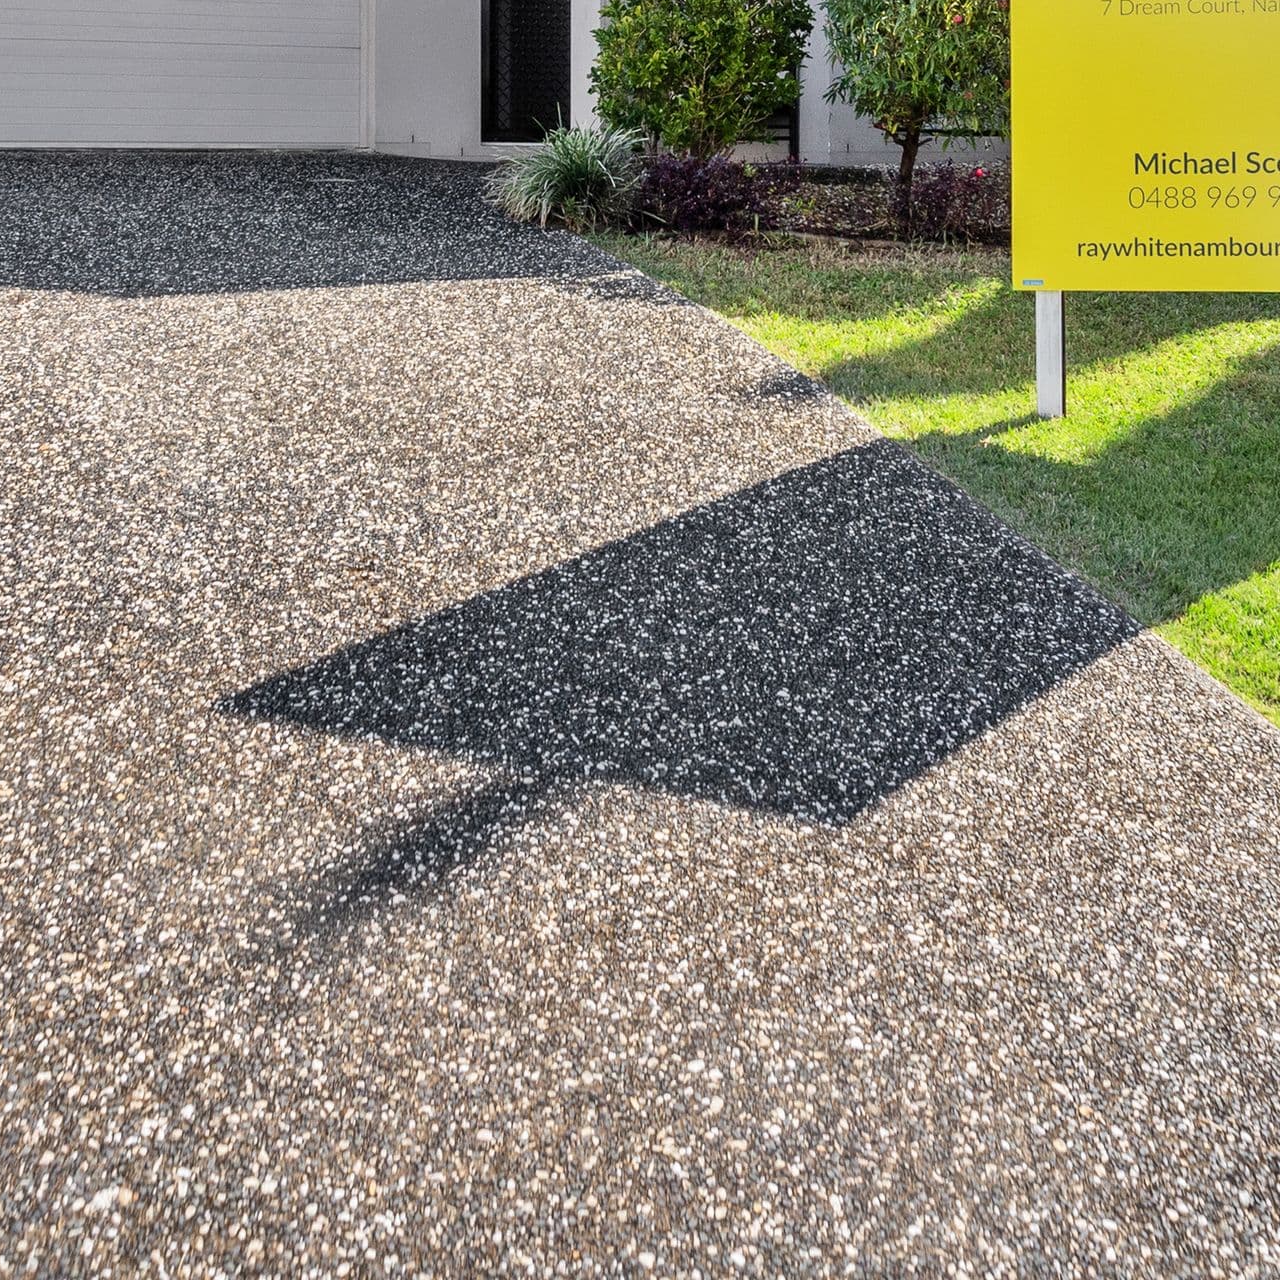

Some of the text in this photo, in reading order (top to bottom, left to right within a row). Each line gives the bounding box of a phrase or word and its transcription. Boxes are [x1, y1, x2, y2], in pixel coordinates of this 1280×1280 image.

[1101, 0, 1112, 16] 7
[1134, 151, 1236, 175] Michael
[1128, 185, 1197, 209] 0488
[1207, 185, 1257, 208] 969
